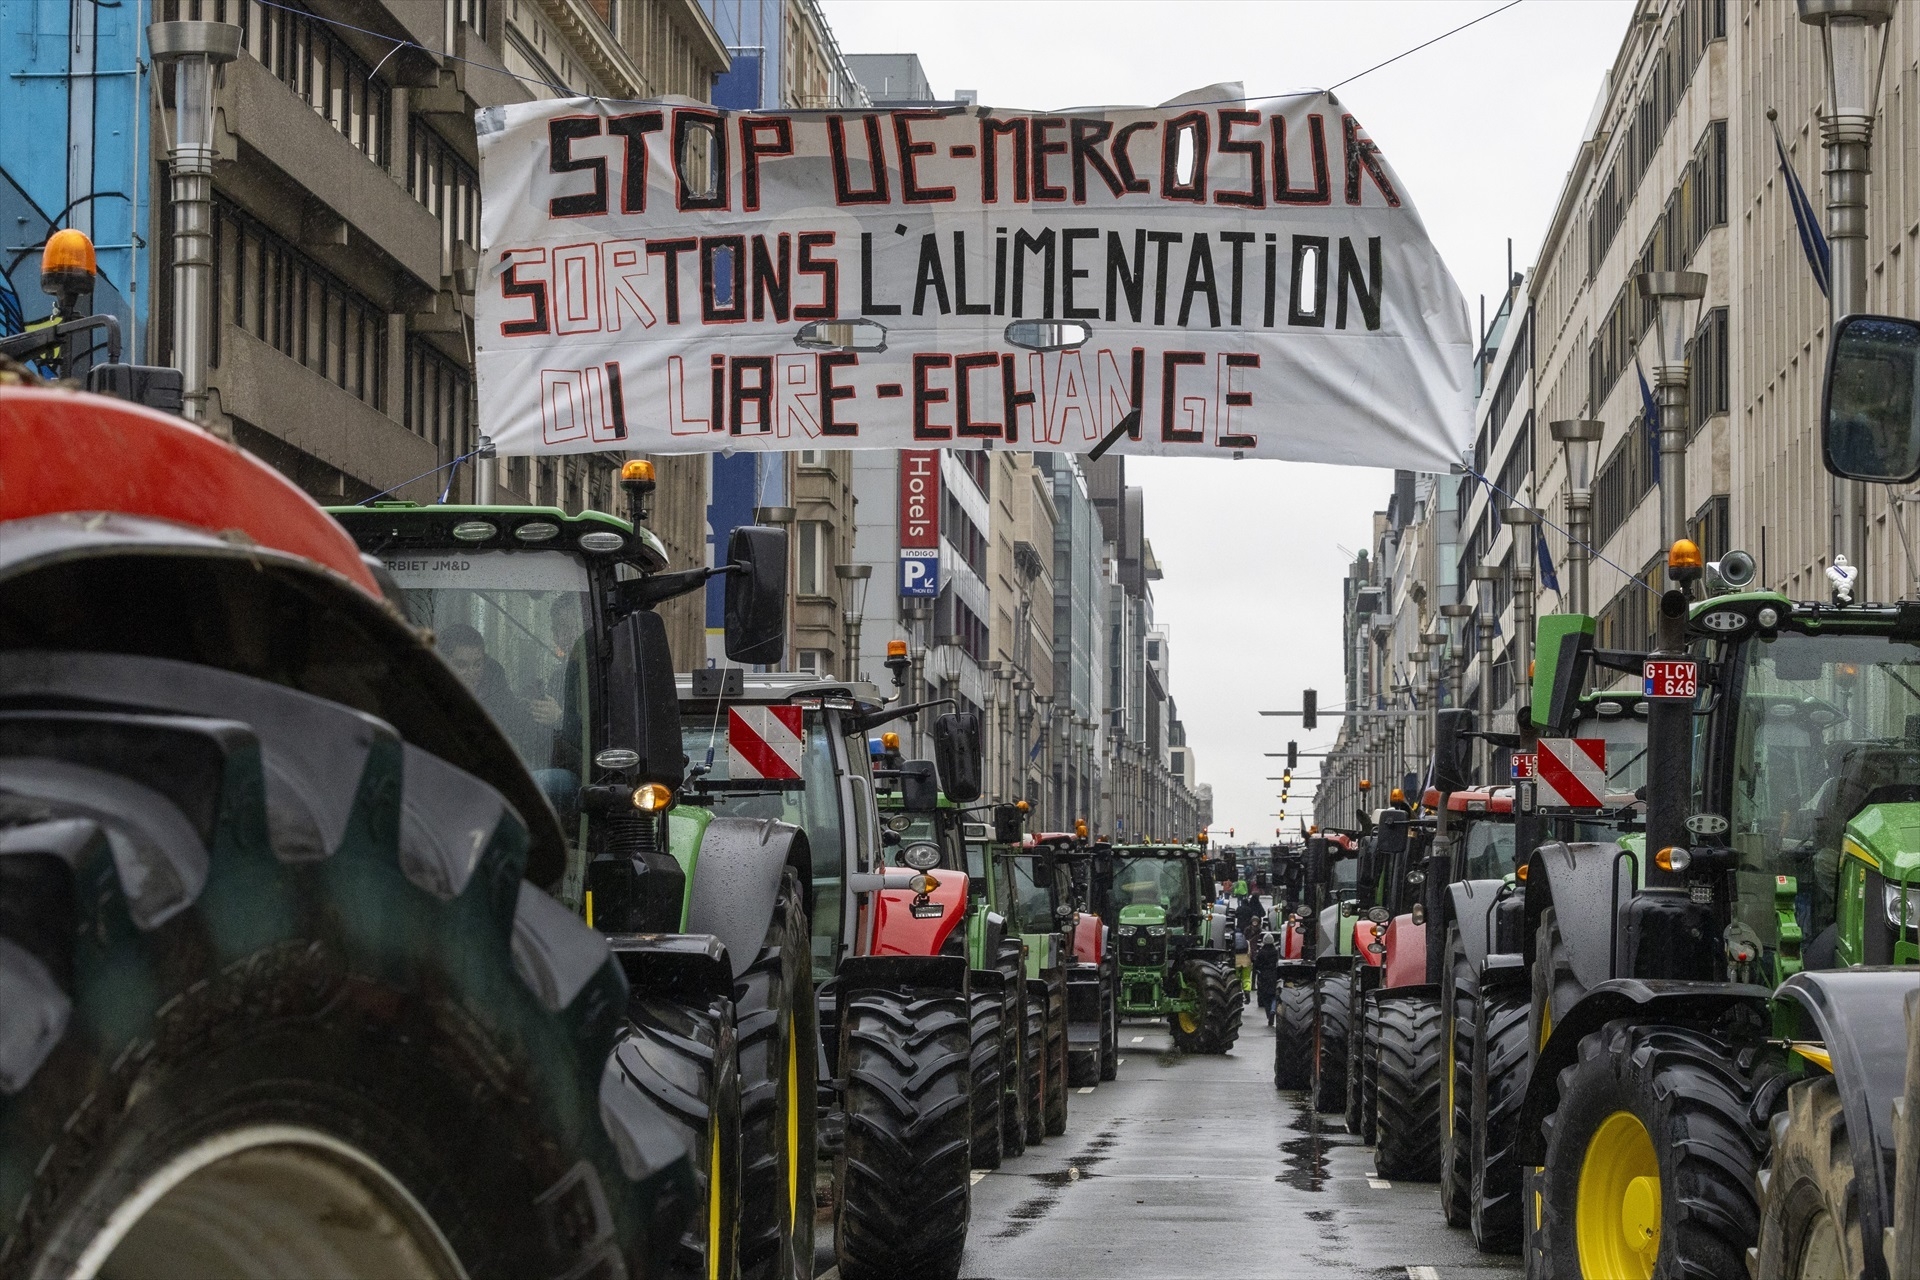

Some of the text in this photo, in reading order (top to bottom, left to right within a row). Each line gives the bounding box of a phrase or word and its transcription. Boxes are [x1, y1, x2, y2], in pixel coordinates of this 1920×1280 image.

[548, 107, 794, 219] STOP
[500, 231, 838, 337] SORTONS
[909, 457, 931, 537] Hotels
[432, 560, 470, 571] JM&D
[904, 560, 926, 588] P
[1645, 663, 1695, 680] G-LCV
[1665, 679, 1695, 696] 646
